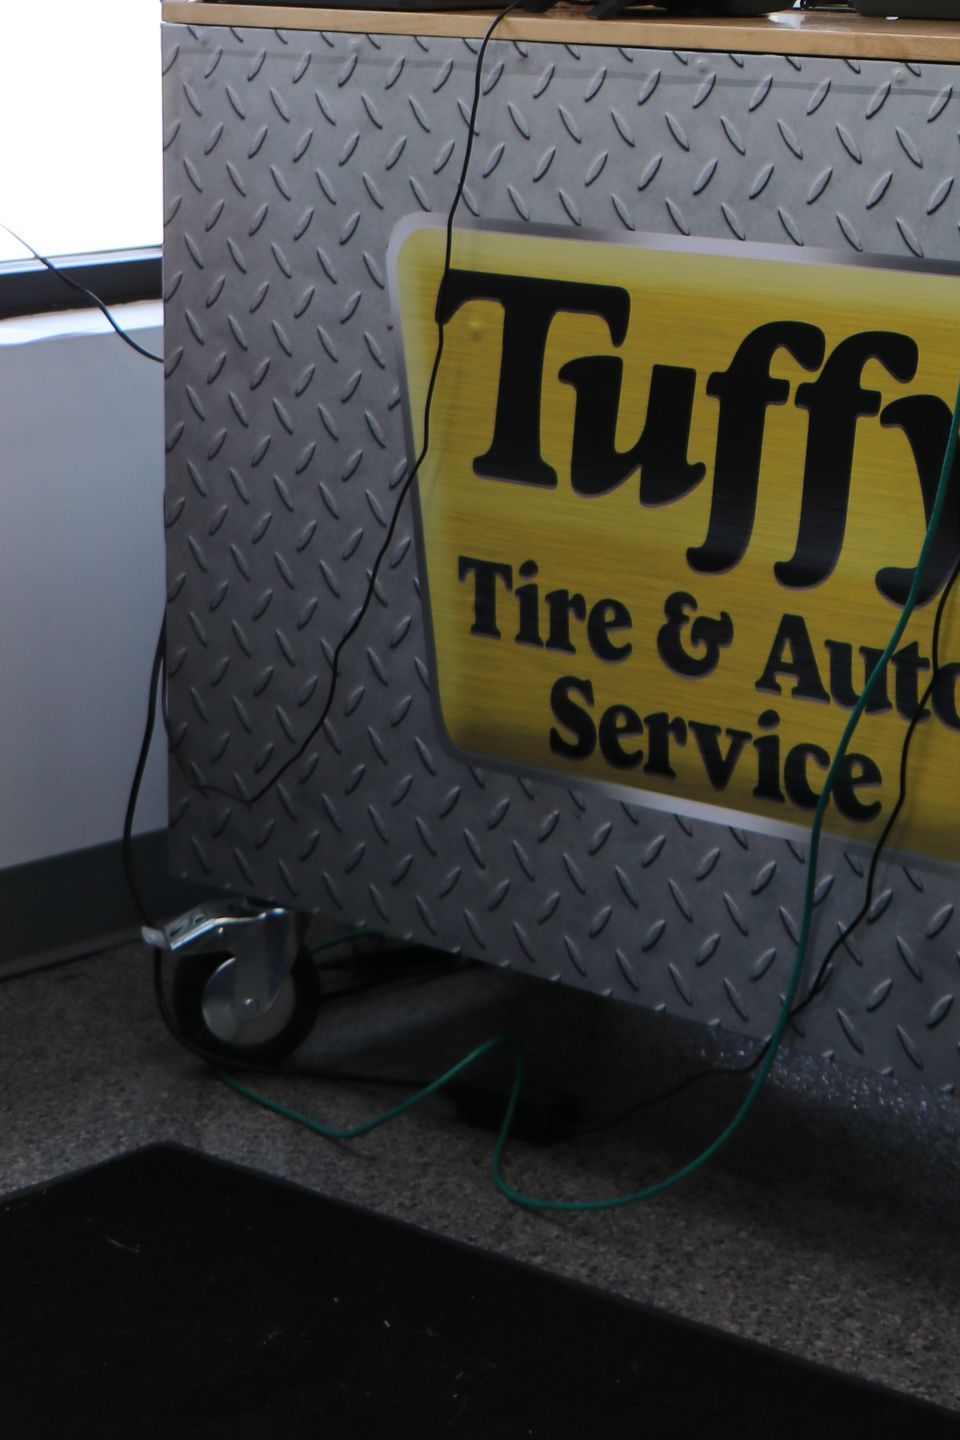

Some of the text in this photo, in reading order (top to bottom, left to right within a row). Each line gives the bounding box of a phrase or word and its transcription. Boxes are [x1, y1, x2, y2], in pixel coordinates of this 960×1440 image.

[456, 554, 633, 663] Tire
[656, 590, 734, 680] &
[549, 674, 883, 823] Service
